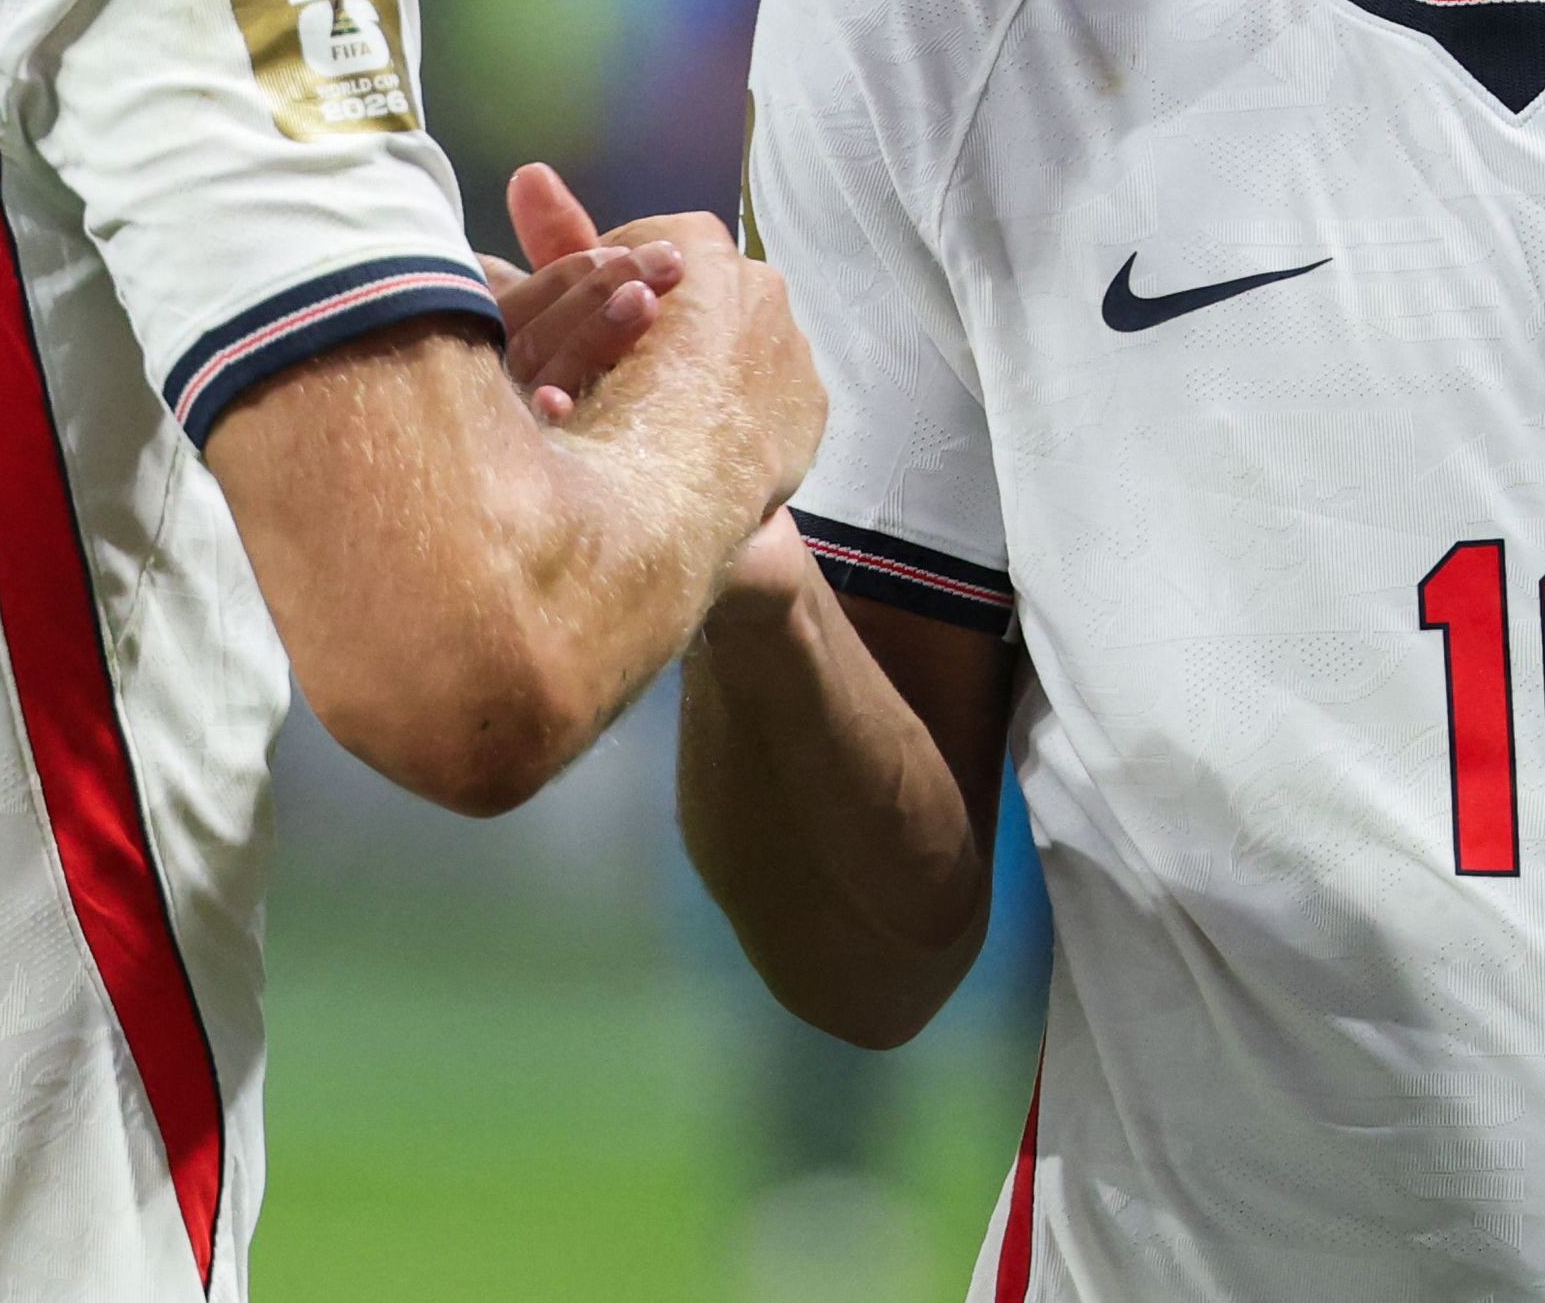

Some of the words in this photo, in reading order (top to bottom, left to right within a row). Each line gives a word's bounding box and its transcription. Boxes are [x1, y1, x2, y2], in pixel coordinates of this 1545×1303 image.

[330, 42, 373, 61] FIFA
[316, 78, 372, 98] WORLD
[321, 90, 409, 122] 2026
